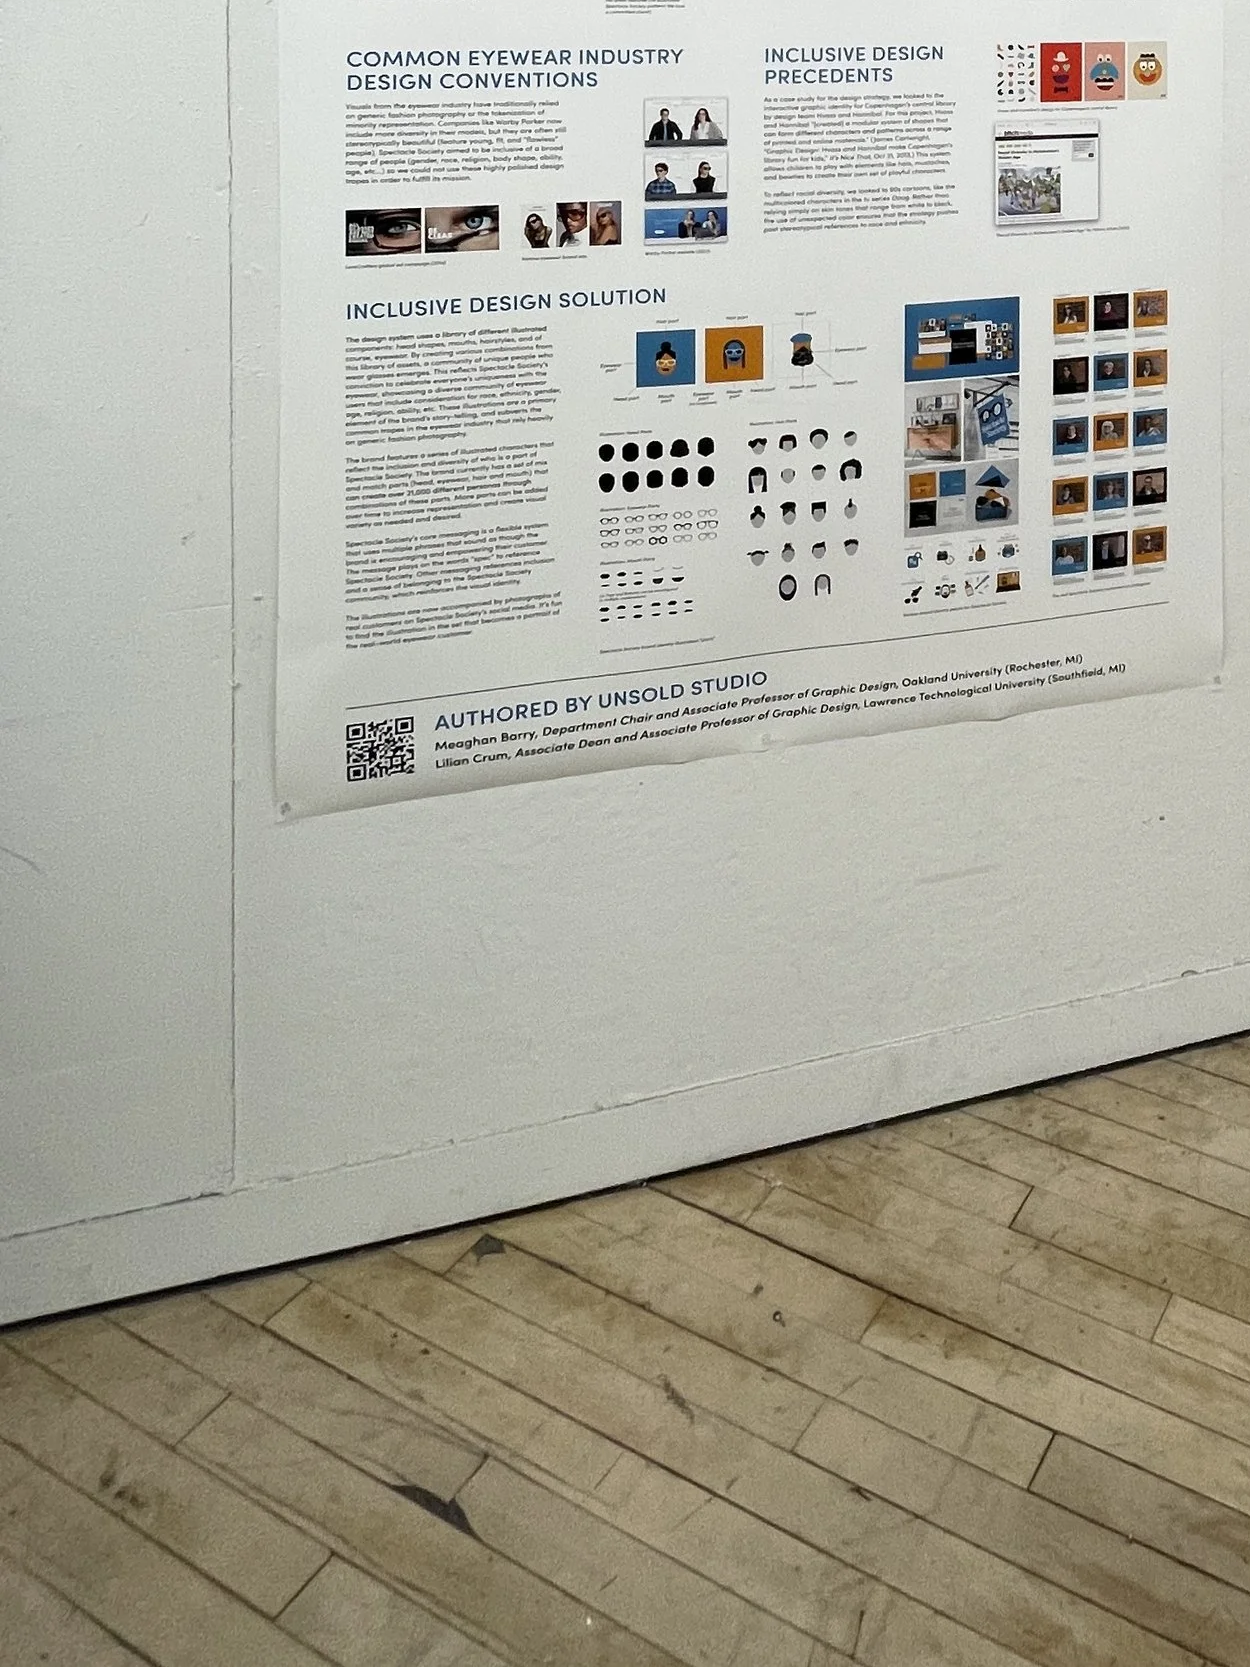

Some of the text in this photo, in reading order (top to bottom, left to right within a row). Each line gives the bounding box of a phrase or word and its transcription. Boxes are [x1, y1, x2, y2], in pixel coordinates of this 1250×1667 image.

[347, 49, 683, 66] COMMON EYEWEAR INDUSTRY
[765, 46, 943, 62] INCLUSIVE DESIGN
[347, 72, 597, 90] DESIGN CONVENTIONS
[765, 68, 892, 83] PRECEDENTS
[347, 289, 665, 319] INCLUSIVE DESIGN SOLUTION
[434, 672, 767, 729] AUTHORED BY UNSOLD STUDIO
[435, 654, 1082, 750] Meaghan Barry, Department Chair and Associate Professor of Graphic Design, Oakland University (Rochester, MI)
[436, 664, 1125, 768] Lilian Crum, Associate Dean and Associate Professor of Graphic Design, Lawrence Technological University (Southfield, MI)
